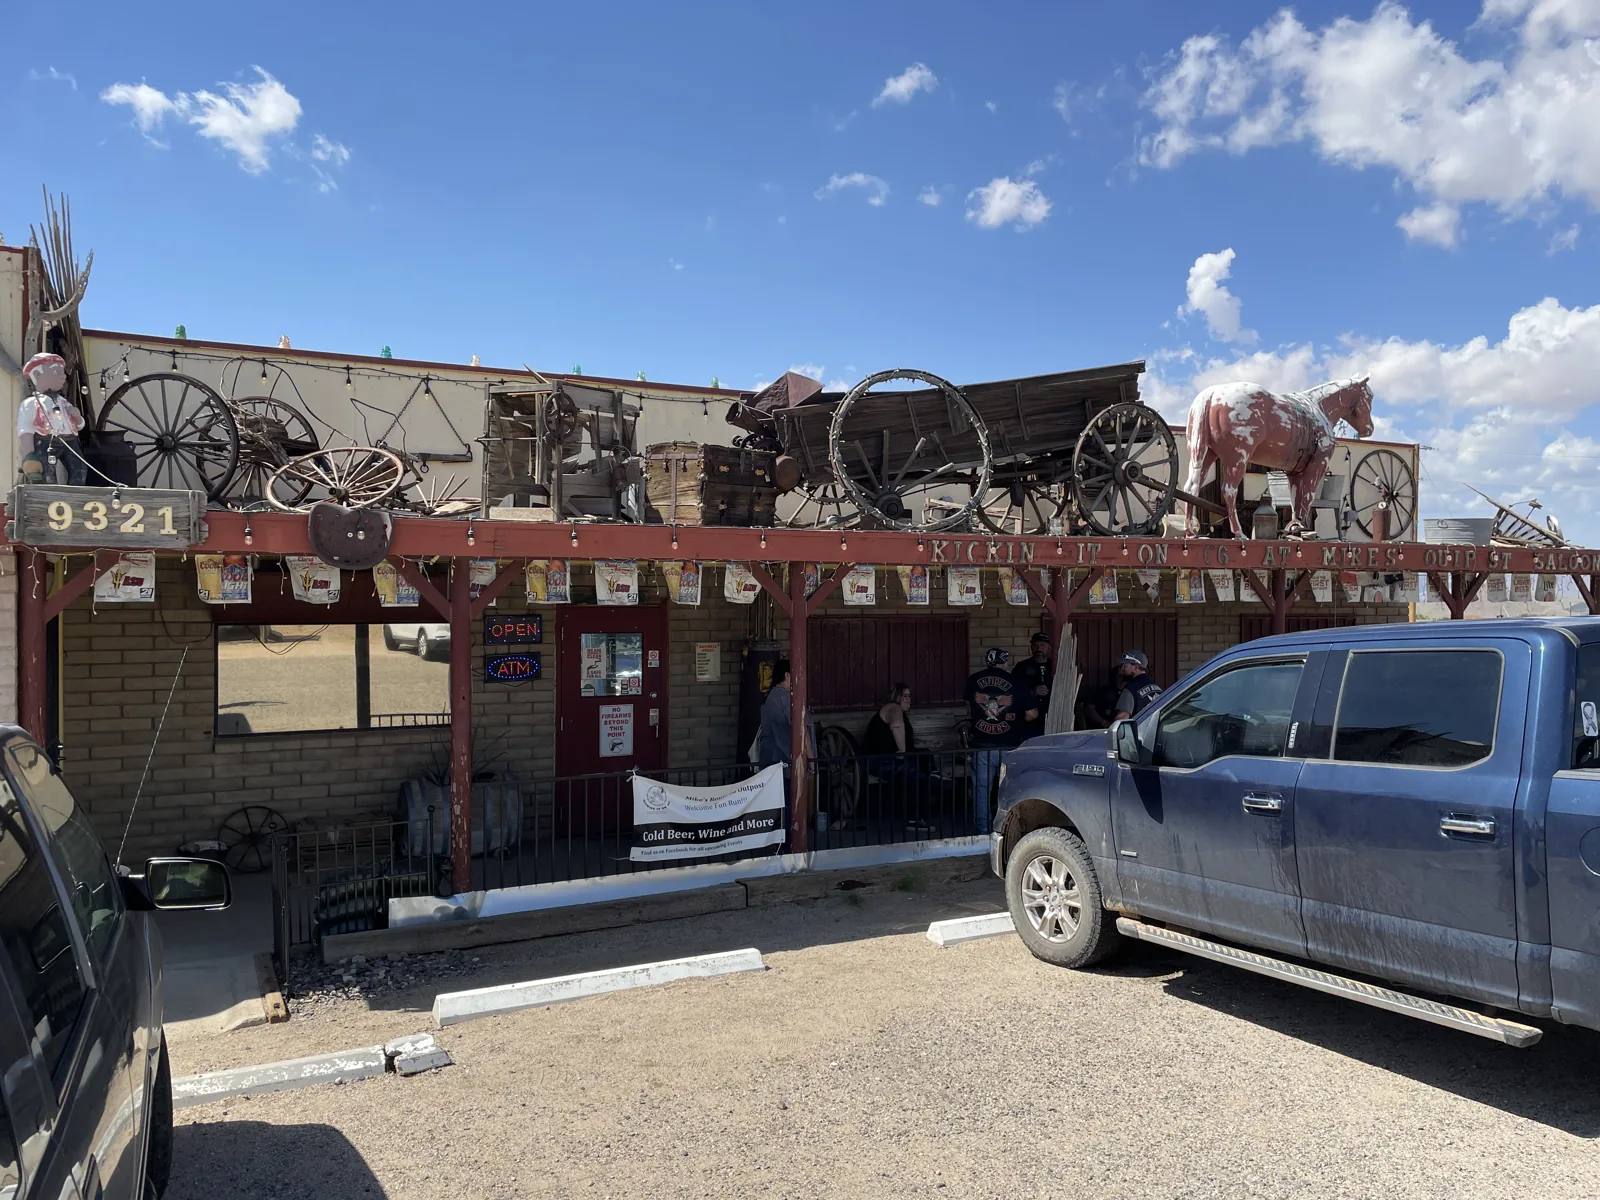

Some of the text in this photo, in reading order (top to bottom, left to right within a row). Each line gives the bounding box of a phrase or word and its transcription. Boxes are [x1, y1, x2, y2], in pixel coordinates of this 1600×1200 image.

[48, 501, 178, 535] 9321
[931, 539, 1036, 563] KICKIN
[1077, 543, 1101, 564] IT
[1137, 543, 1168, 564] ON
[1262, 546, 1290, 567] AT
[1322, 546, 1396, 568] MIKES
[492, 623, 537, 637] OPEN
[497, 661, 530, 675] ATM
[978, 721, 1008, 733] RIDERS
[643, 818, 774, 842] Cold Beer, Wine and More
